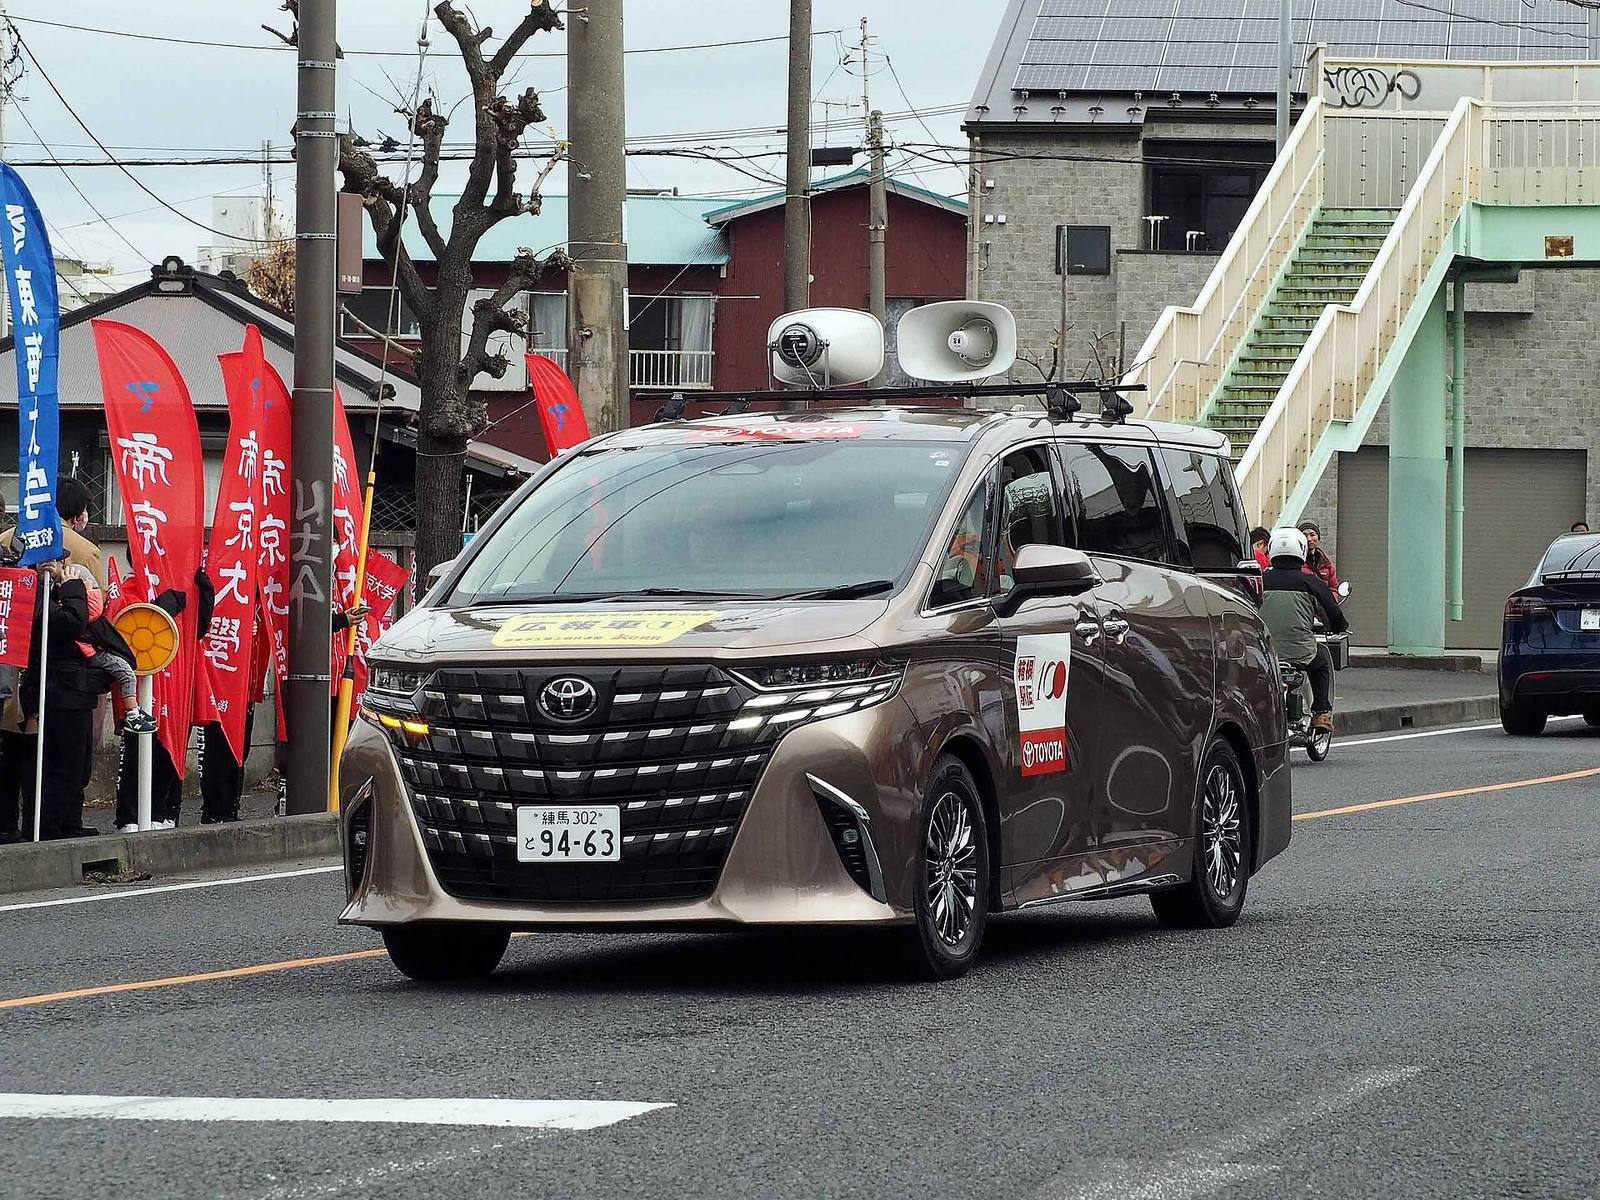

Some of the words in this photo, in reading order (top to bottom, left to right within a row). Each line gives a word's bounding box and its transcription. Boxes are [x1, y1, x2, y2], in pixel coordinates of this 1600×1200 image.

[746, 424, 856, 436] TOYOTA
[1034, 740, 1063, 764] TOYOTA
[542, 811, 570, 825] 練馬
[572, 810, 598, 825] 302
[525, 837, 535, 850] と
[540, 829, 614, 857] 94-63
